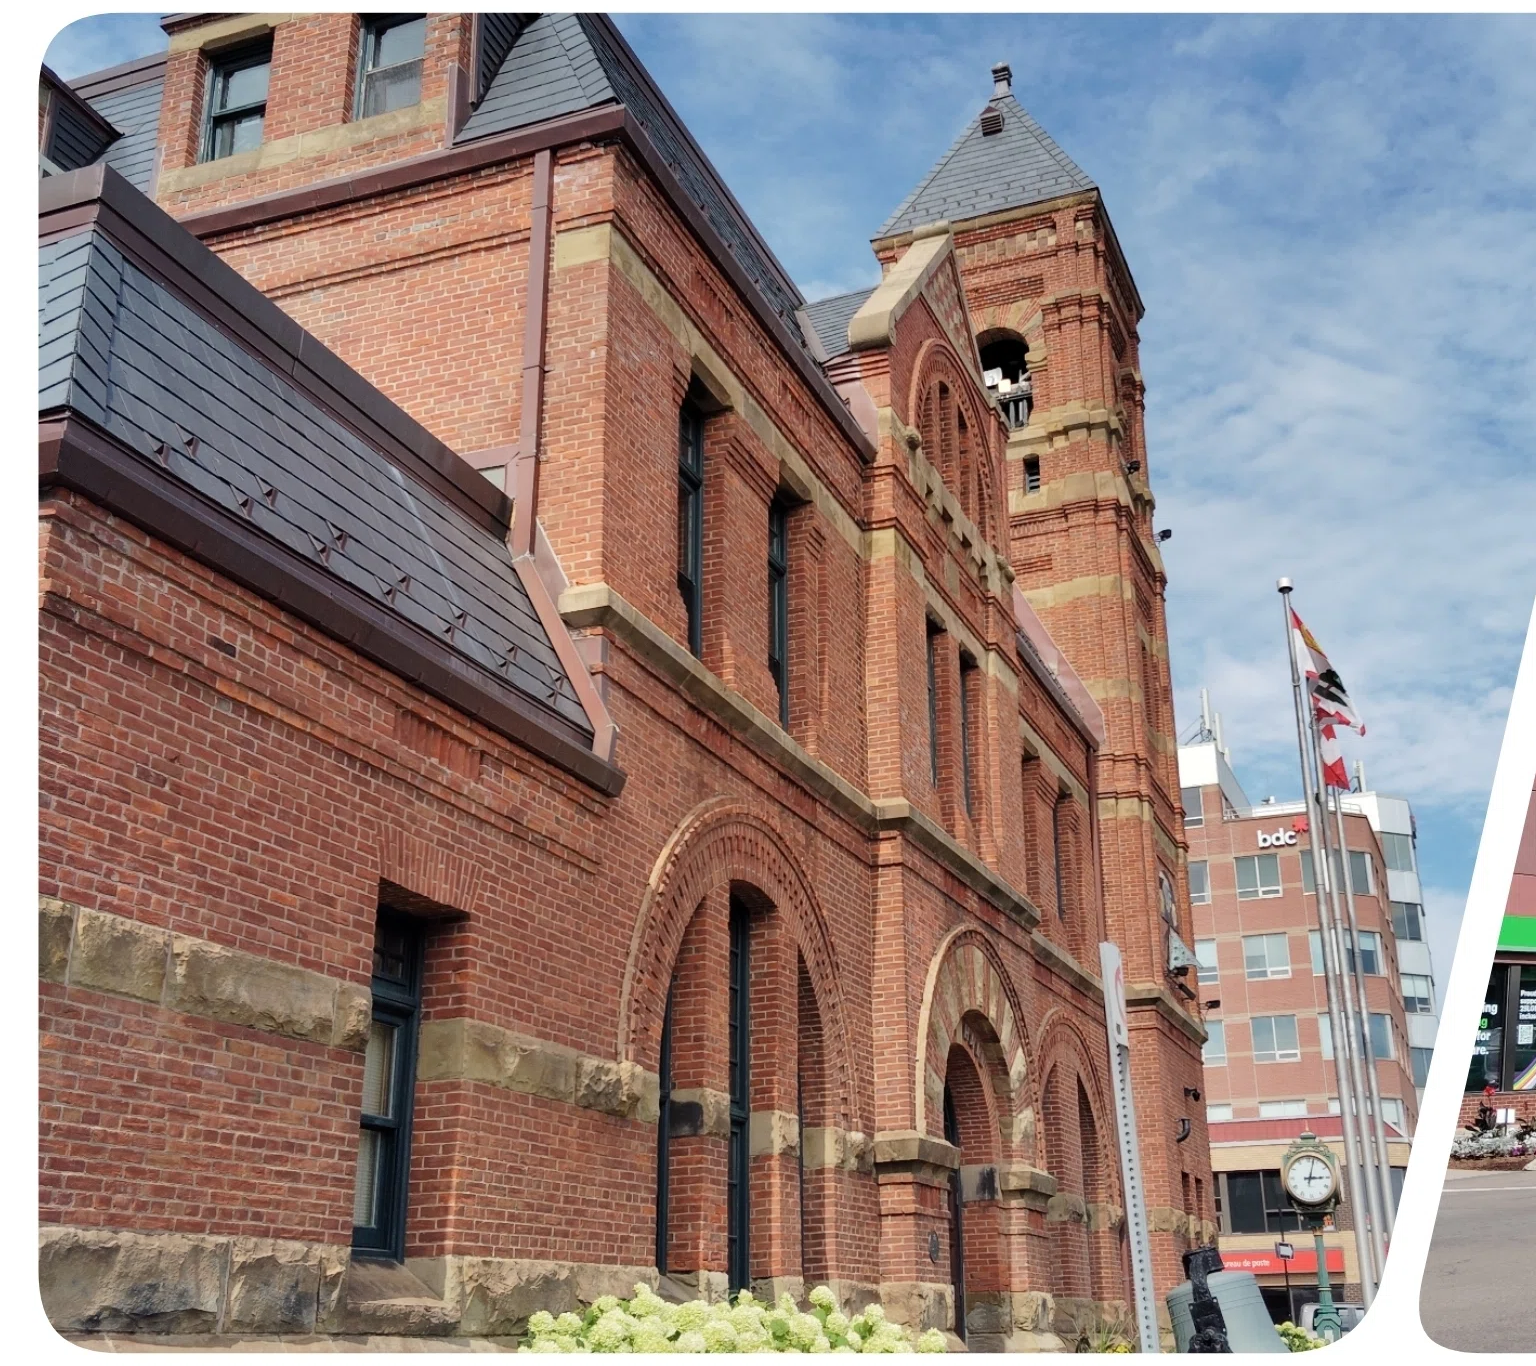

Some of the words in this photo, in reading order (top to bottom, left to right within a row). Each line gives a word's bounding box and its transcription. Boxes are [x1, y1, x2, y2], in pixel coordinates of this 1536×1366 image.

[1257, 828, 1297, 847] bdc
[1243, 1259, 1251, 1267] de
[1252, 1260, 1270, 1268] poste
